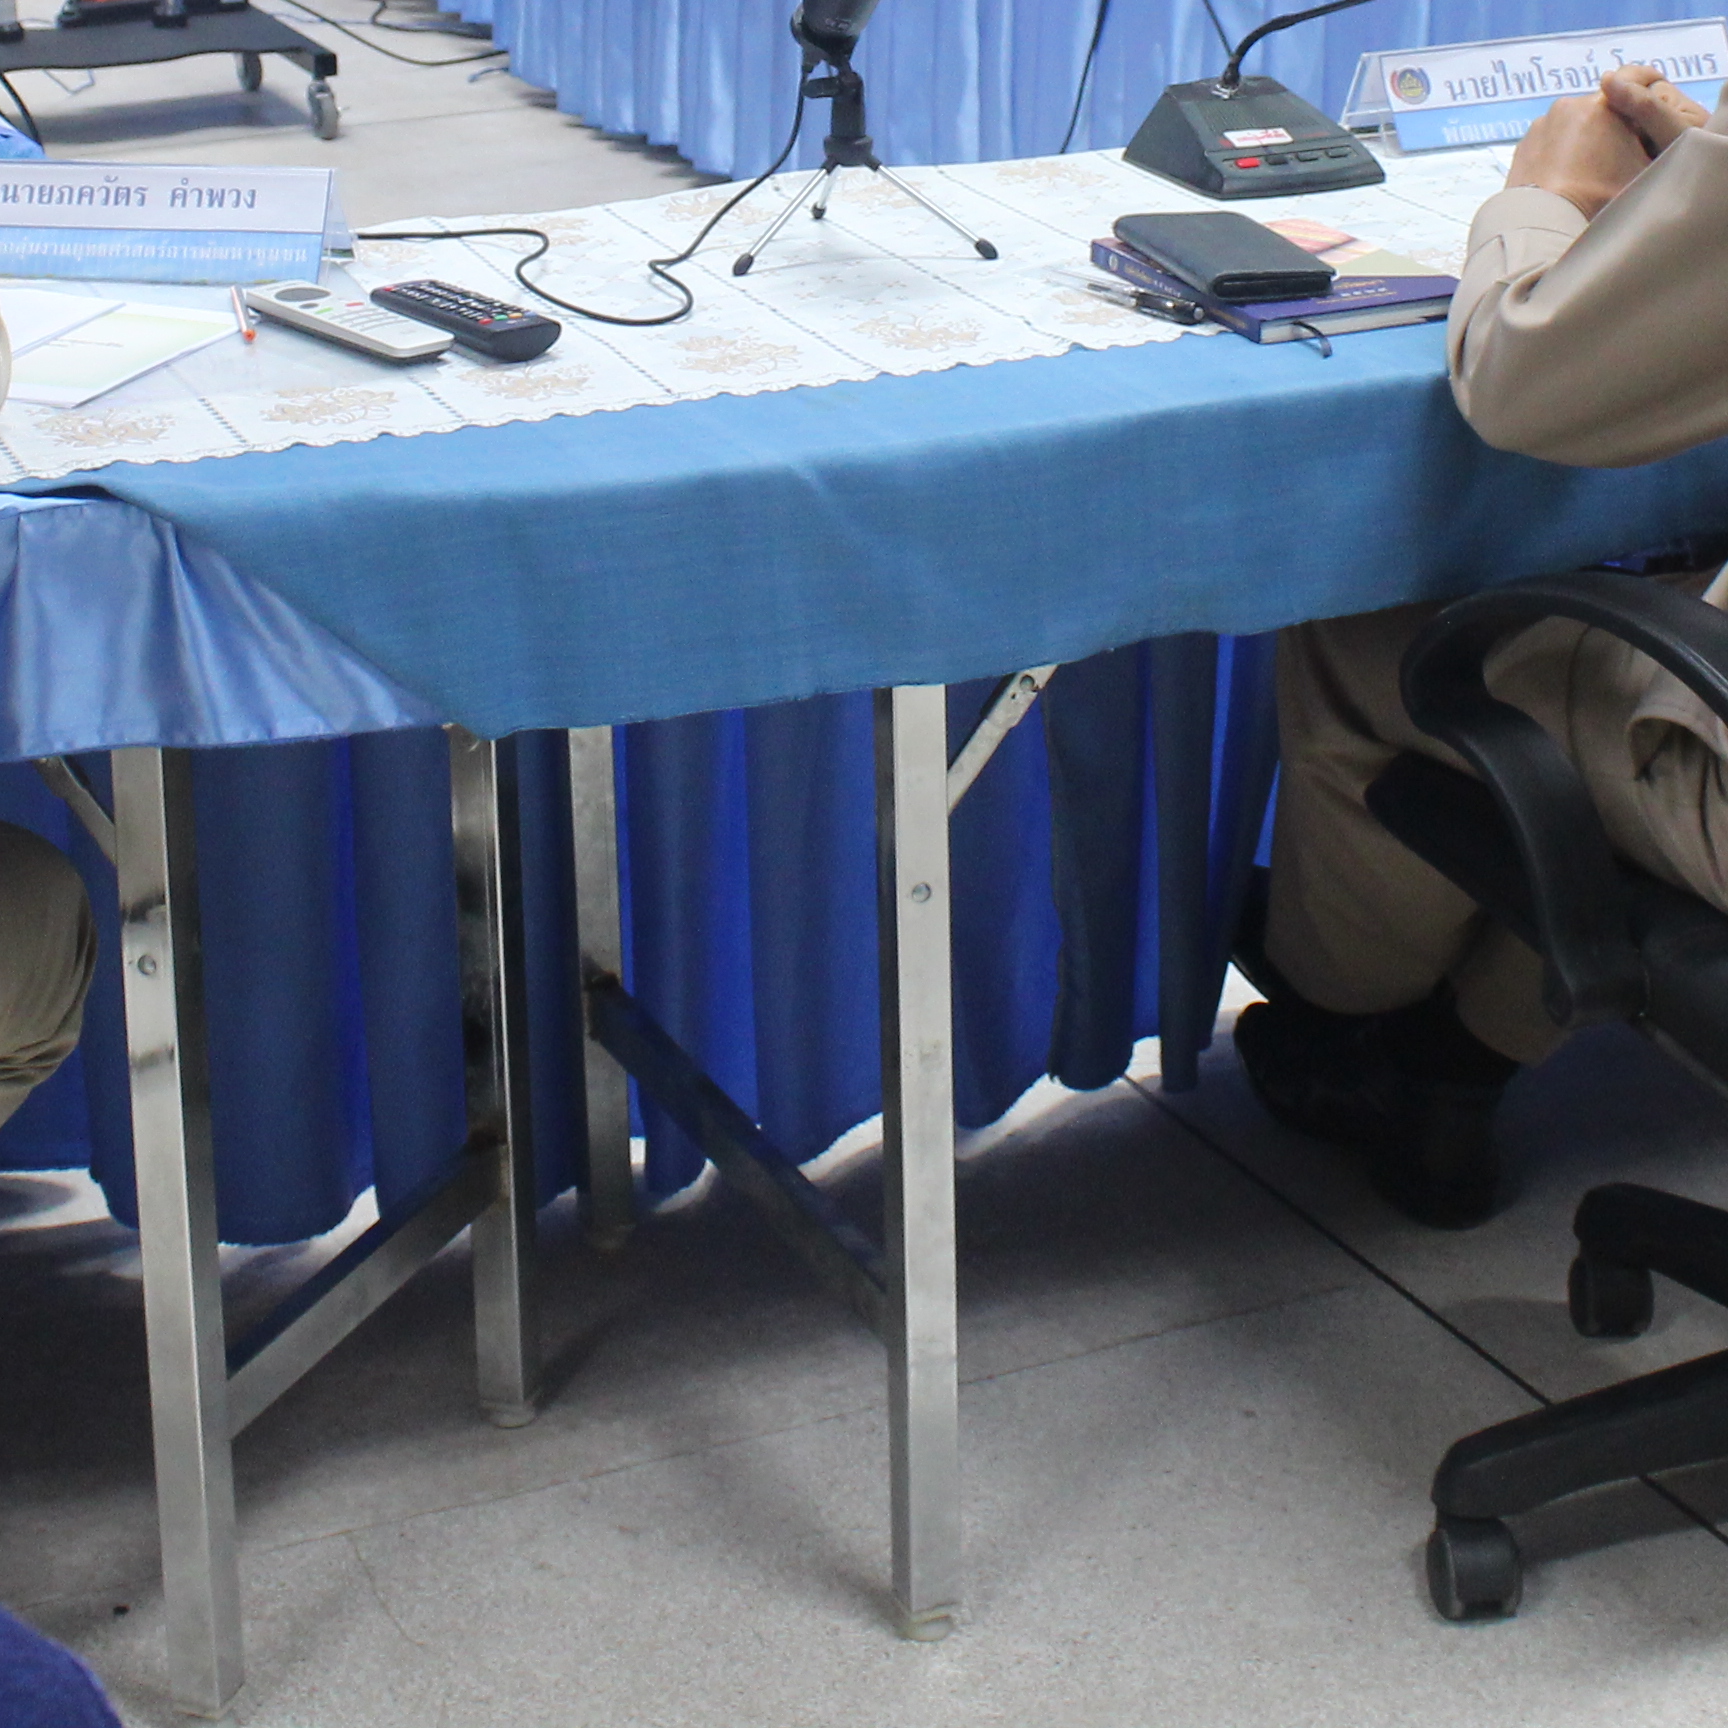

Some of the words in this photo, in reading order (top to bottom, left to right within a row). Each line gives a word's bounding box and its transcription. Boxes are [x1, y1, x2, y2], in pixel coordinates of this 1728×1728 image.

[1444, 48, 1602, 102] นายไพโรจน์
[0, 175, 148, 208] นายภควัตร
[169, 178, 257, 211] คำพวง
